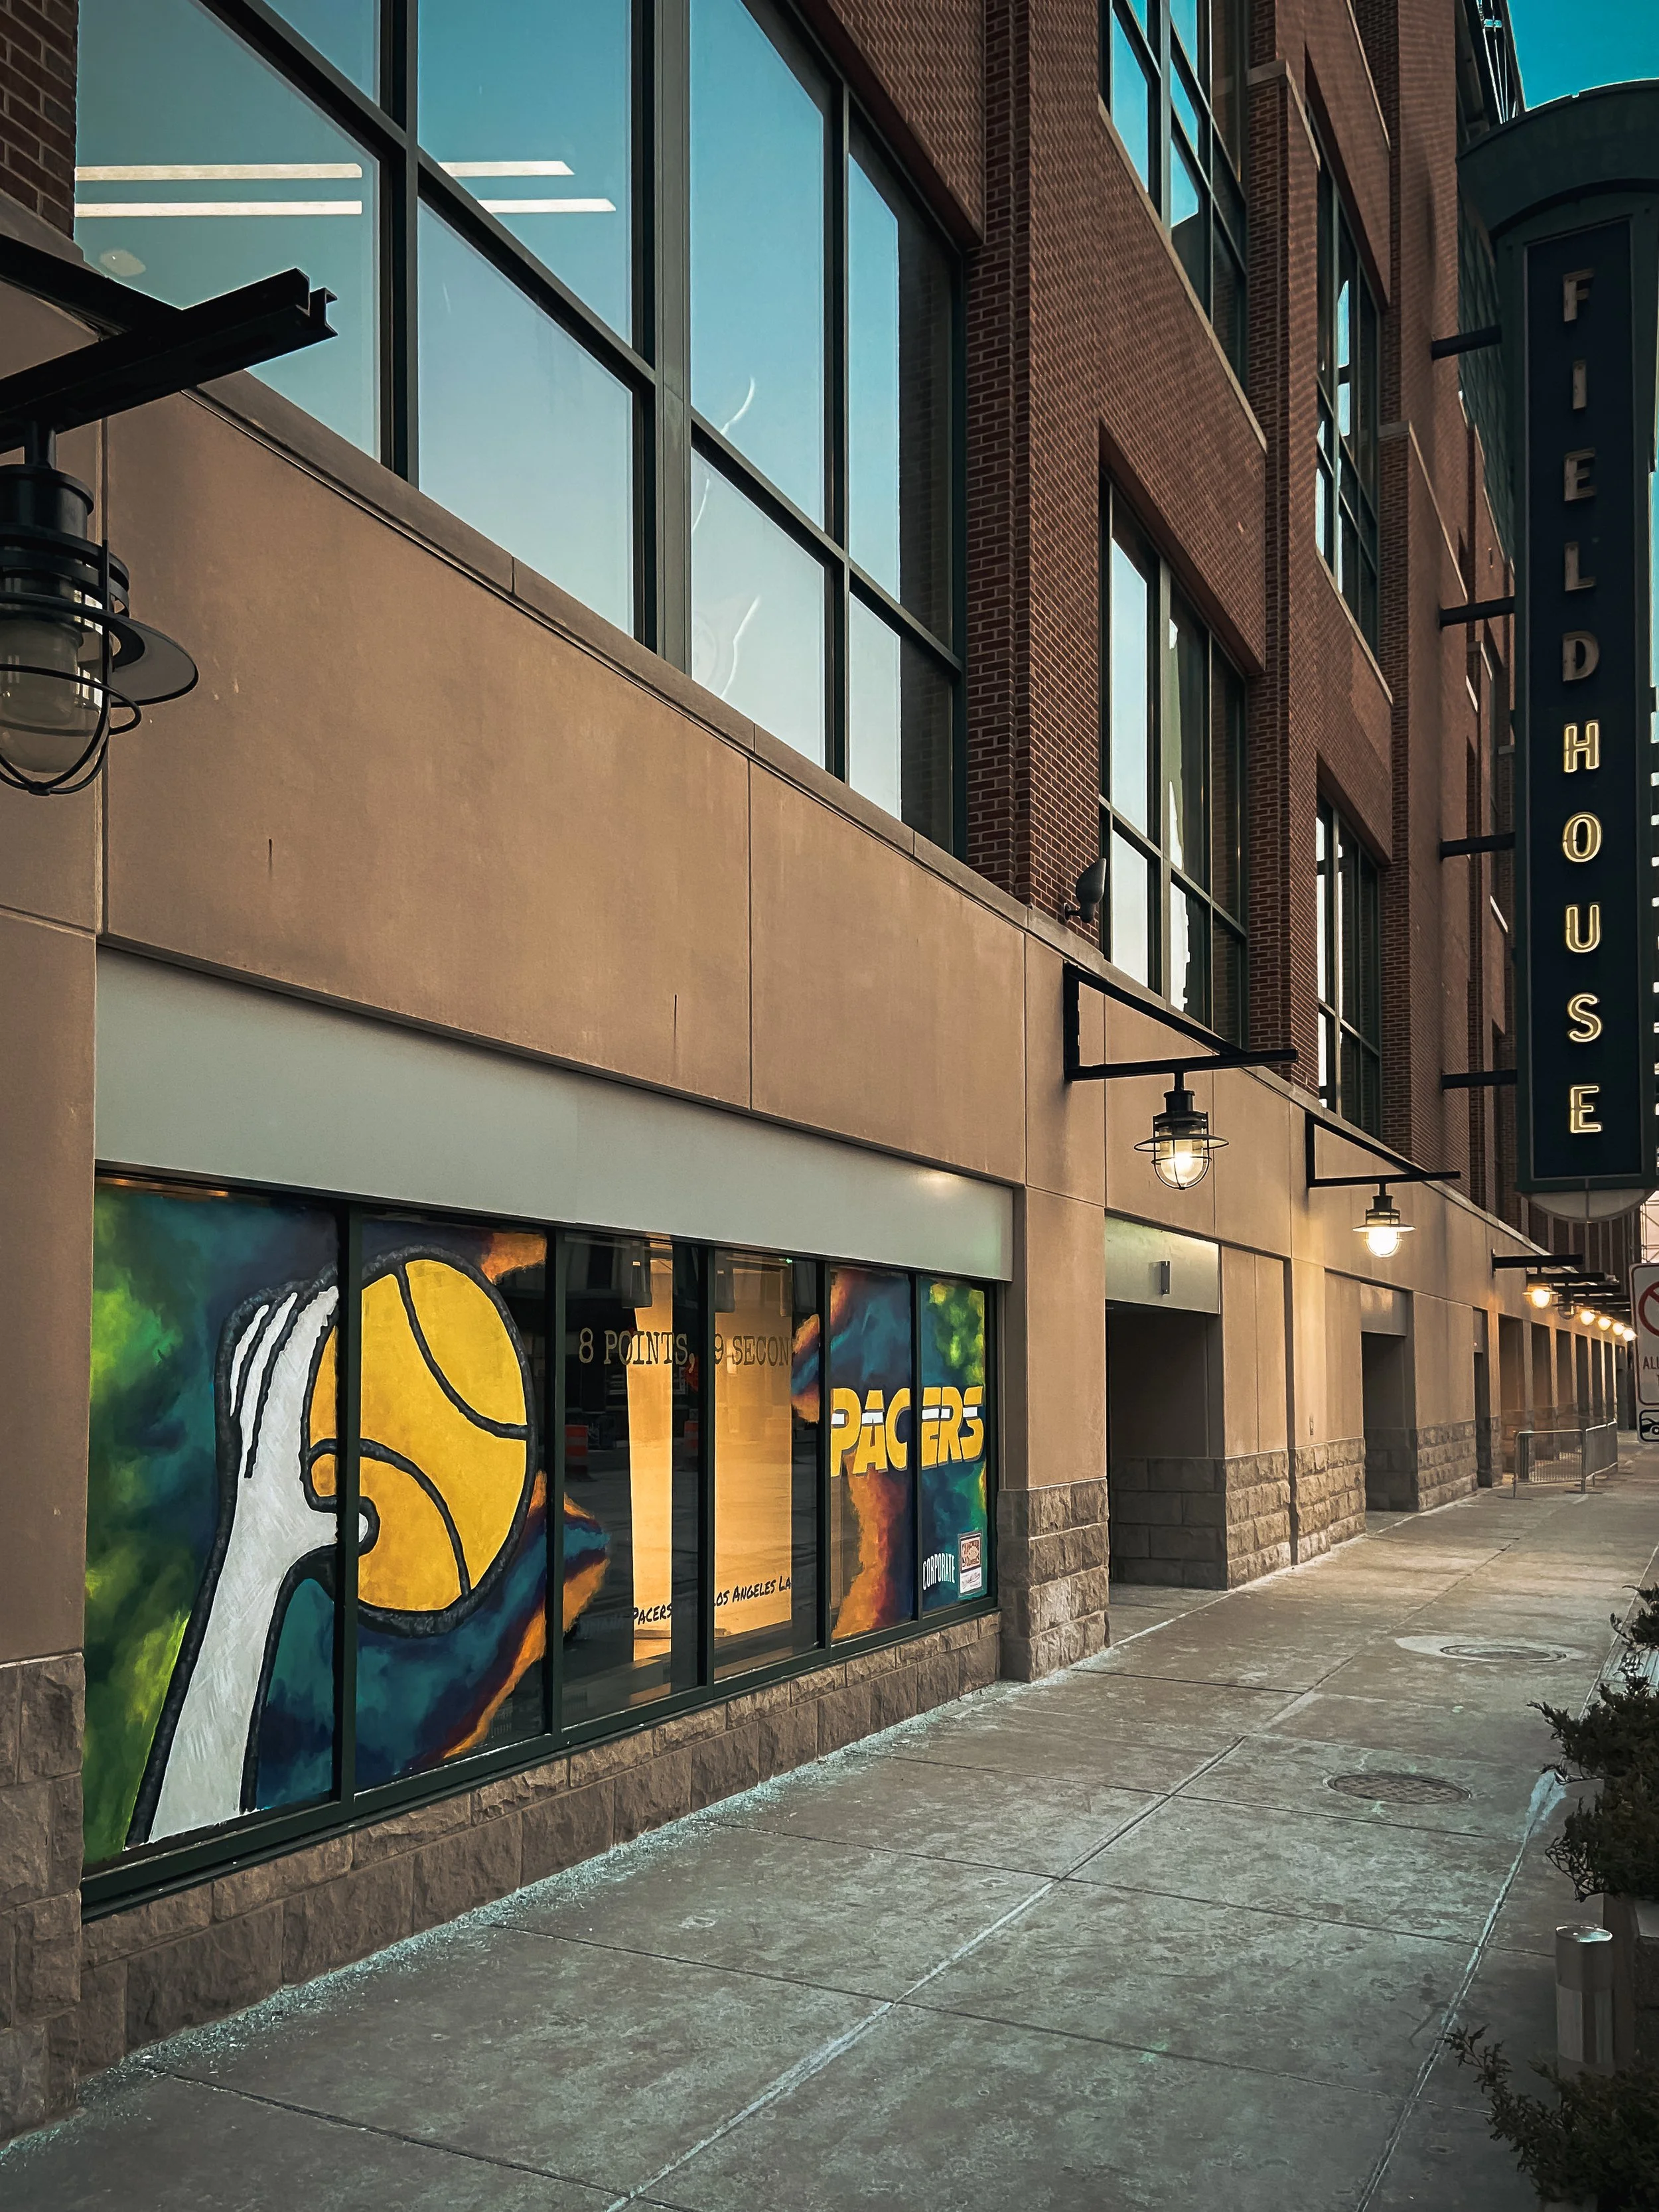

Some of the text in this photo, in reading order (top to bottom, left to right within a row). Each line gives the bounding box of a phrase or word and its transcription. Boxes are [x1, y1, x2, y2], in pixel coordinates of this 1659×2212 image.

[1561, 267, 1603, 1134] FIELDHOUSE
[579, 1327, 594, 1364] 8
[605, 1329, 695, 1374] POINTS,
[715, 1333, 724, 1365] 9
[830, 1386, 984, 1479] PACERS
[713, 1589, 730, 1607] OS
[732, 1579, 777, 1603] ANGELES
[922, 1552, 956, 1591] CORPORATE
